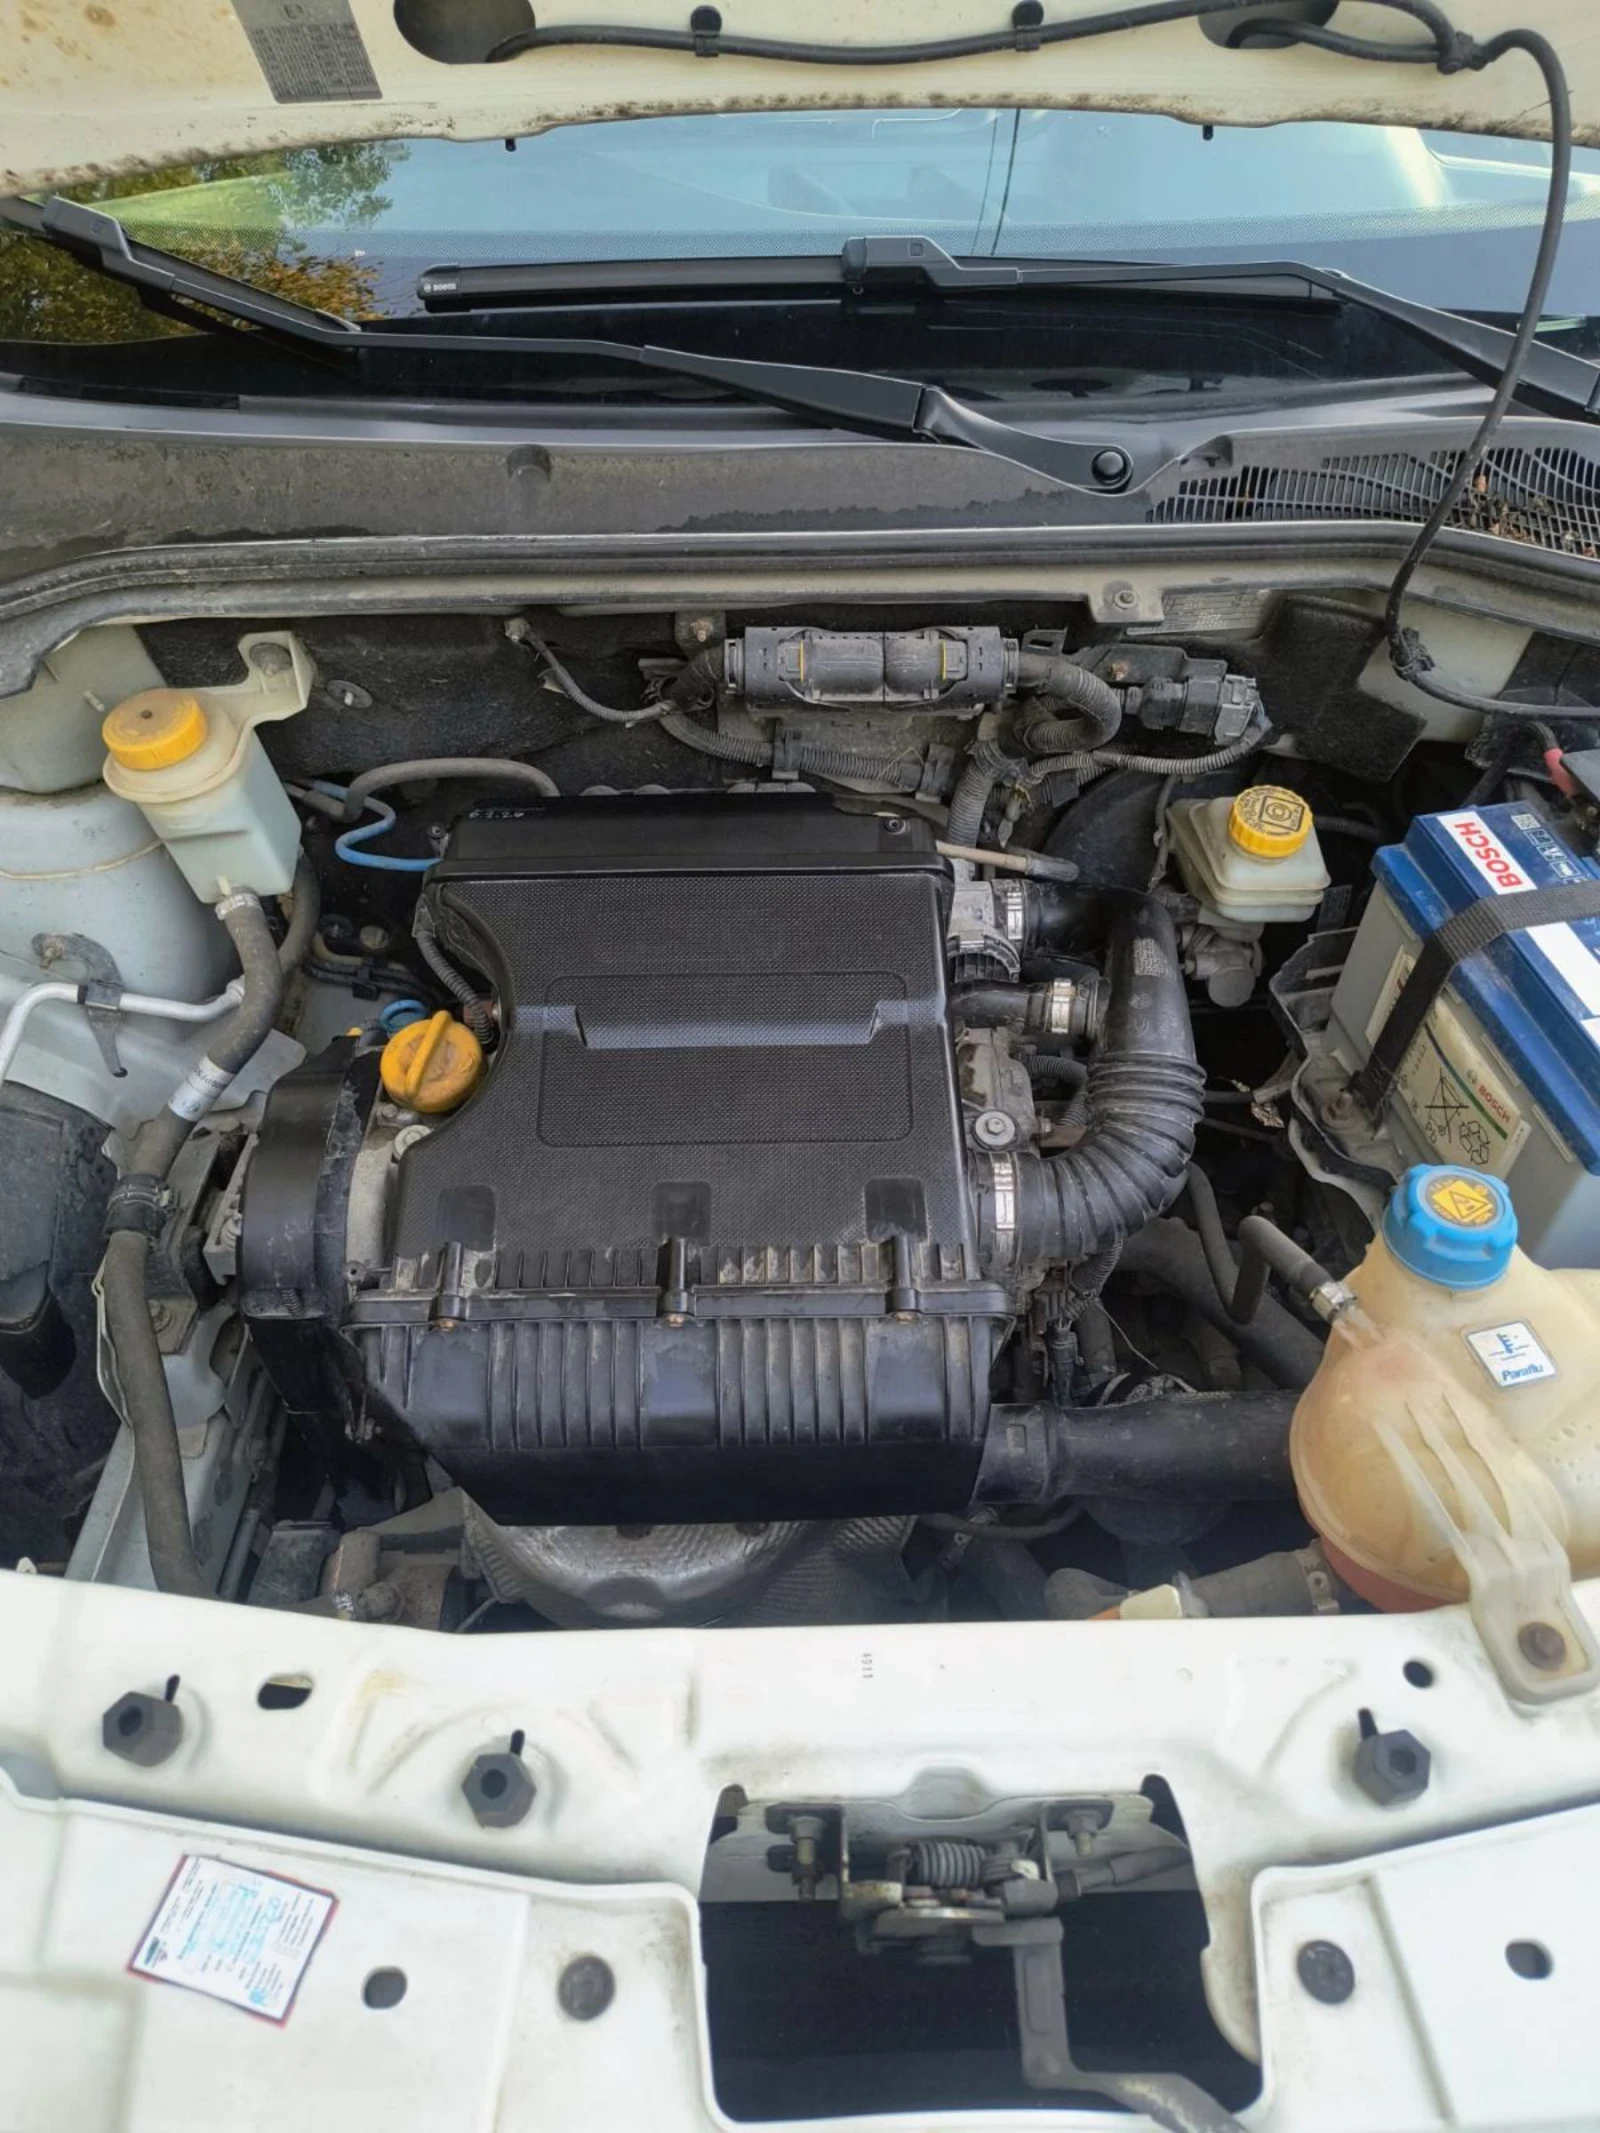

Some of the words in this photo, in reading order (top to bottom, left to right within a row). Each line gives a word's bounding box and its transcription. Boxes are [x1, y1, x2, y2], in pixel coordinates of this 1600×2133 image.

[1454, 821, 1523, 888] BOSCH
[1478, 1085, 1511, 1124] BOSCH
[1502, 1363, 1544, 1381] Paraflu
